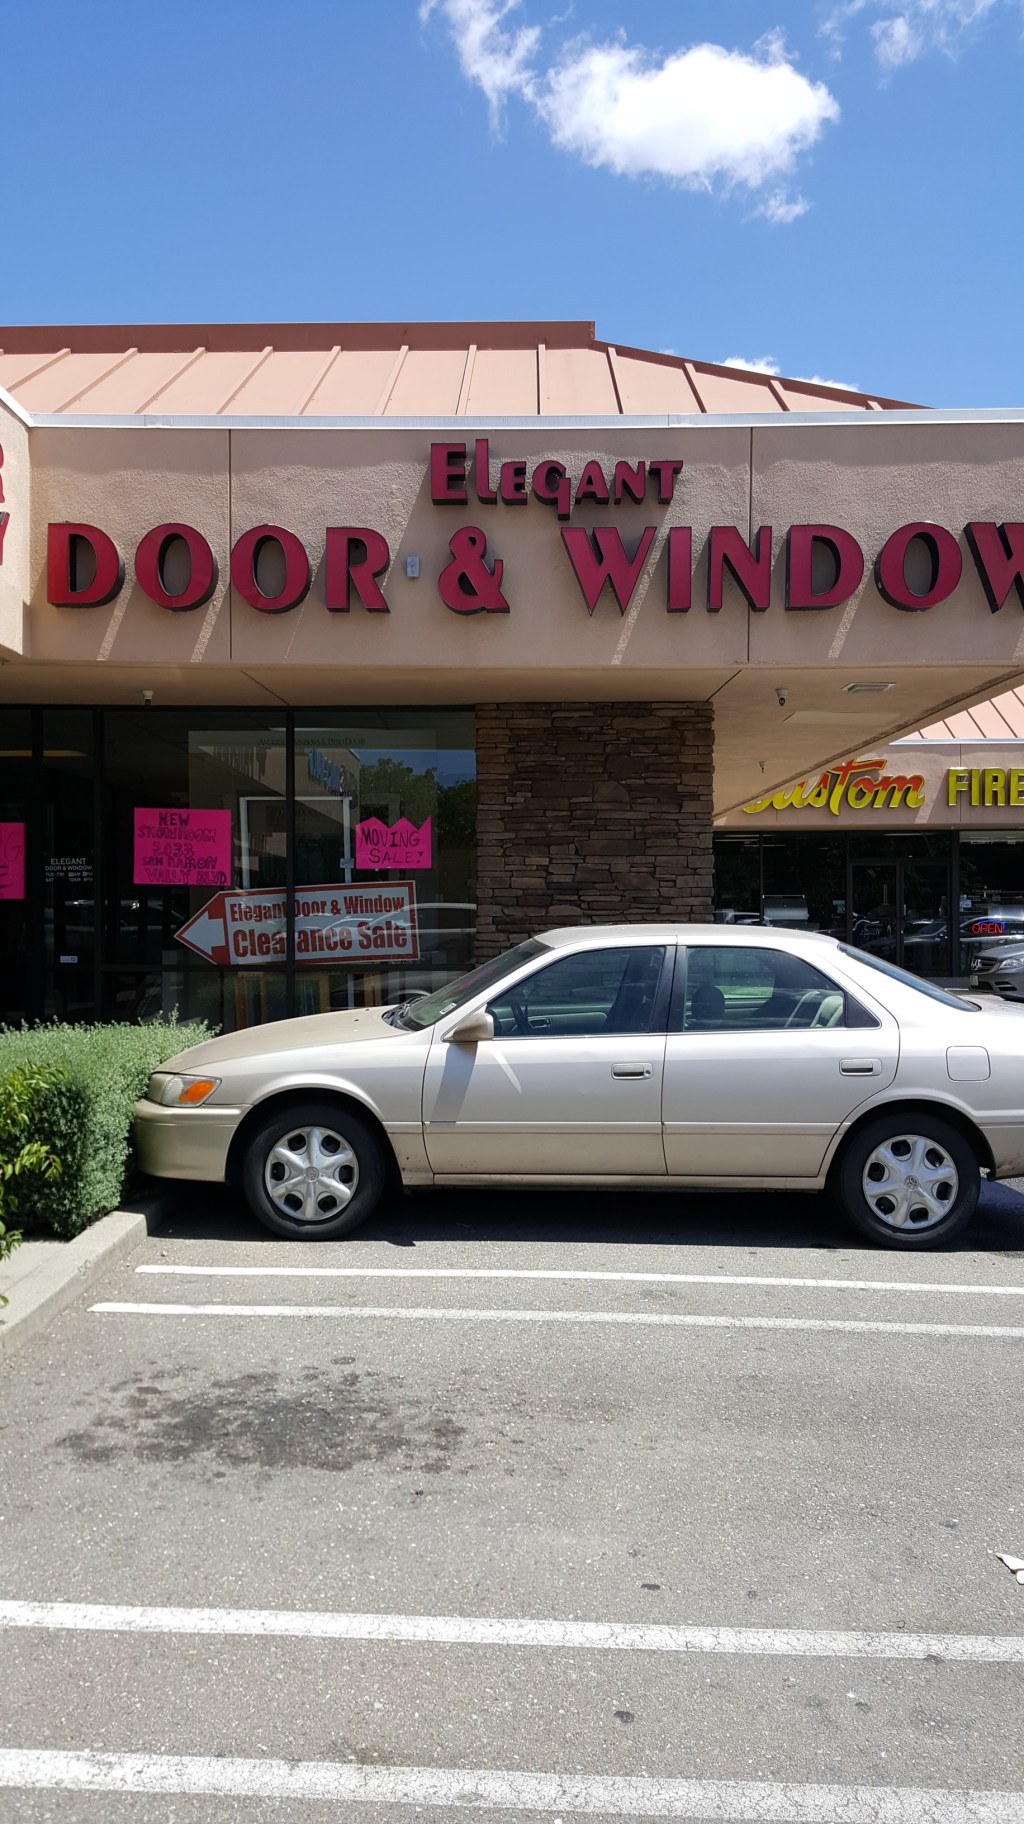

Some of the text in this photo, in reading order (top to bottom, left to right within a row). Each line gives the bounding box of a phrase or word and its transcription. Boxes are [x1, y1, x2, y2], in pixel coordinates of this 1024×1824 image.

[47, 522, 391, 614] DOOR
[437, 525, 511, 615] &
[561, 520, 1024, 616] WINDOW
[158, 812, 190, 827] NEW
[137, 825, 217, 843] SHOWROOM
[360, 827, 420, 848] MOVING
[152, 841, 195, 858] 2033
[368, 848, 424, 864] SALE!
[50, 857, 87, 865] ELEGANT
[142, 856, 218, 870] SAN RAMON
[196, 870, 228, 885] BLVD
[229, 901, 288, 923] Elegant
[330, 899, 341, 916] &
[343, 894, 405, 914] Window
[971, 922, 1003, 935] OPEN
[233, 920, 408, 957] Cleaance Sale
